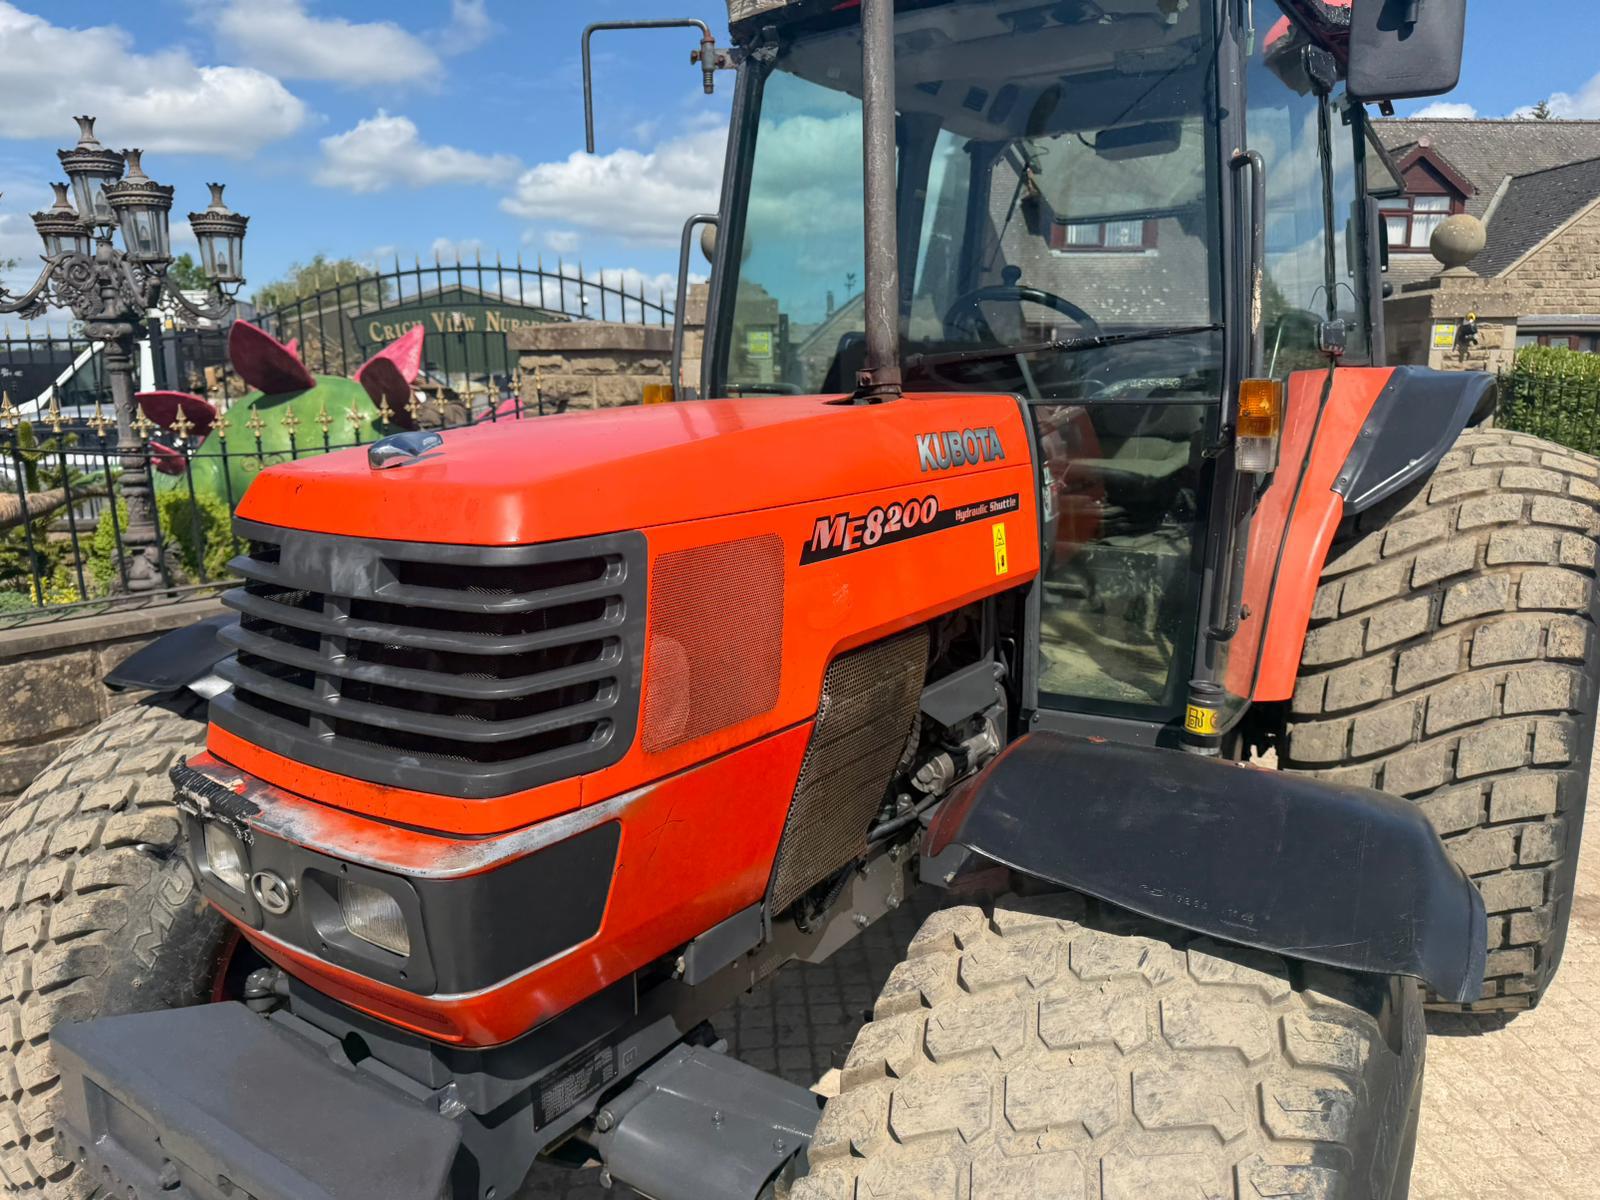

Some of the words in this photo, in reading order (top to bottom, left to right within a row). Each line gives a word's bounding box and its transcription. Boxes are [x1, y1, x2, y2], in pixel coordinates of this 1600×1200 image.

[915, 426, 1005, 472] KUBOTA
[811, 496, 939, 551] ME8200
[955, 503, 988, 521] Hydraulic
[989, 497, 1017, 513] Shuttle
